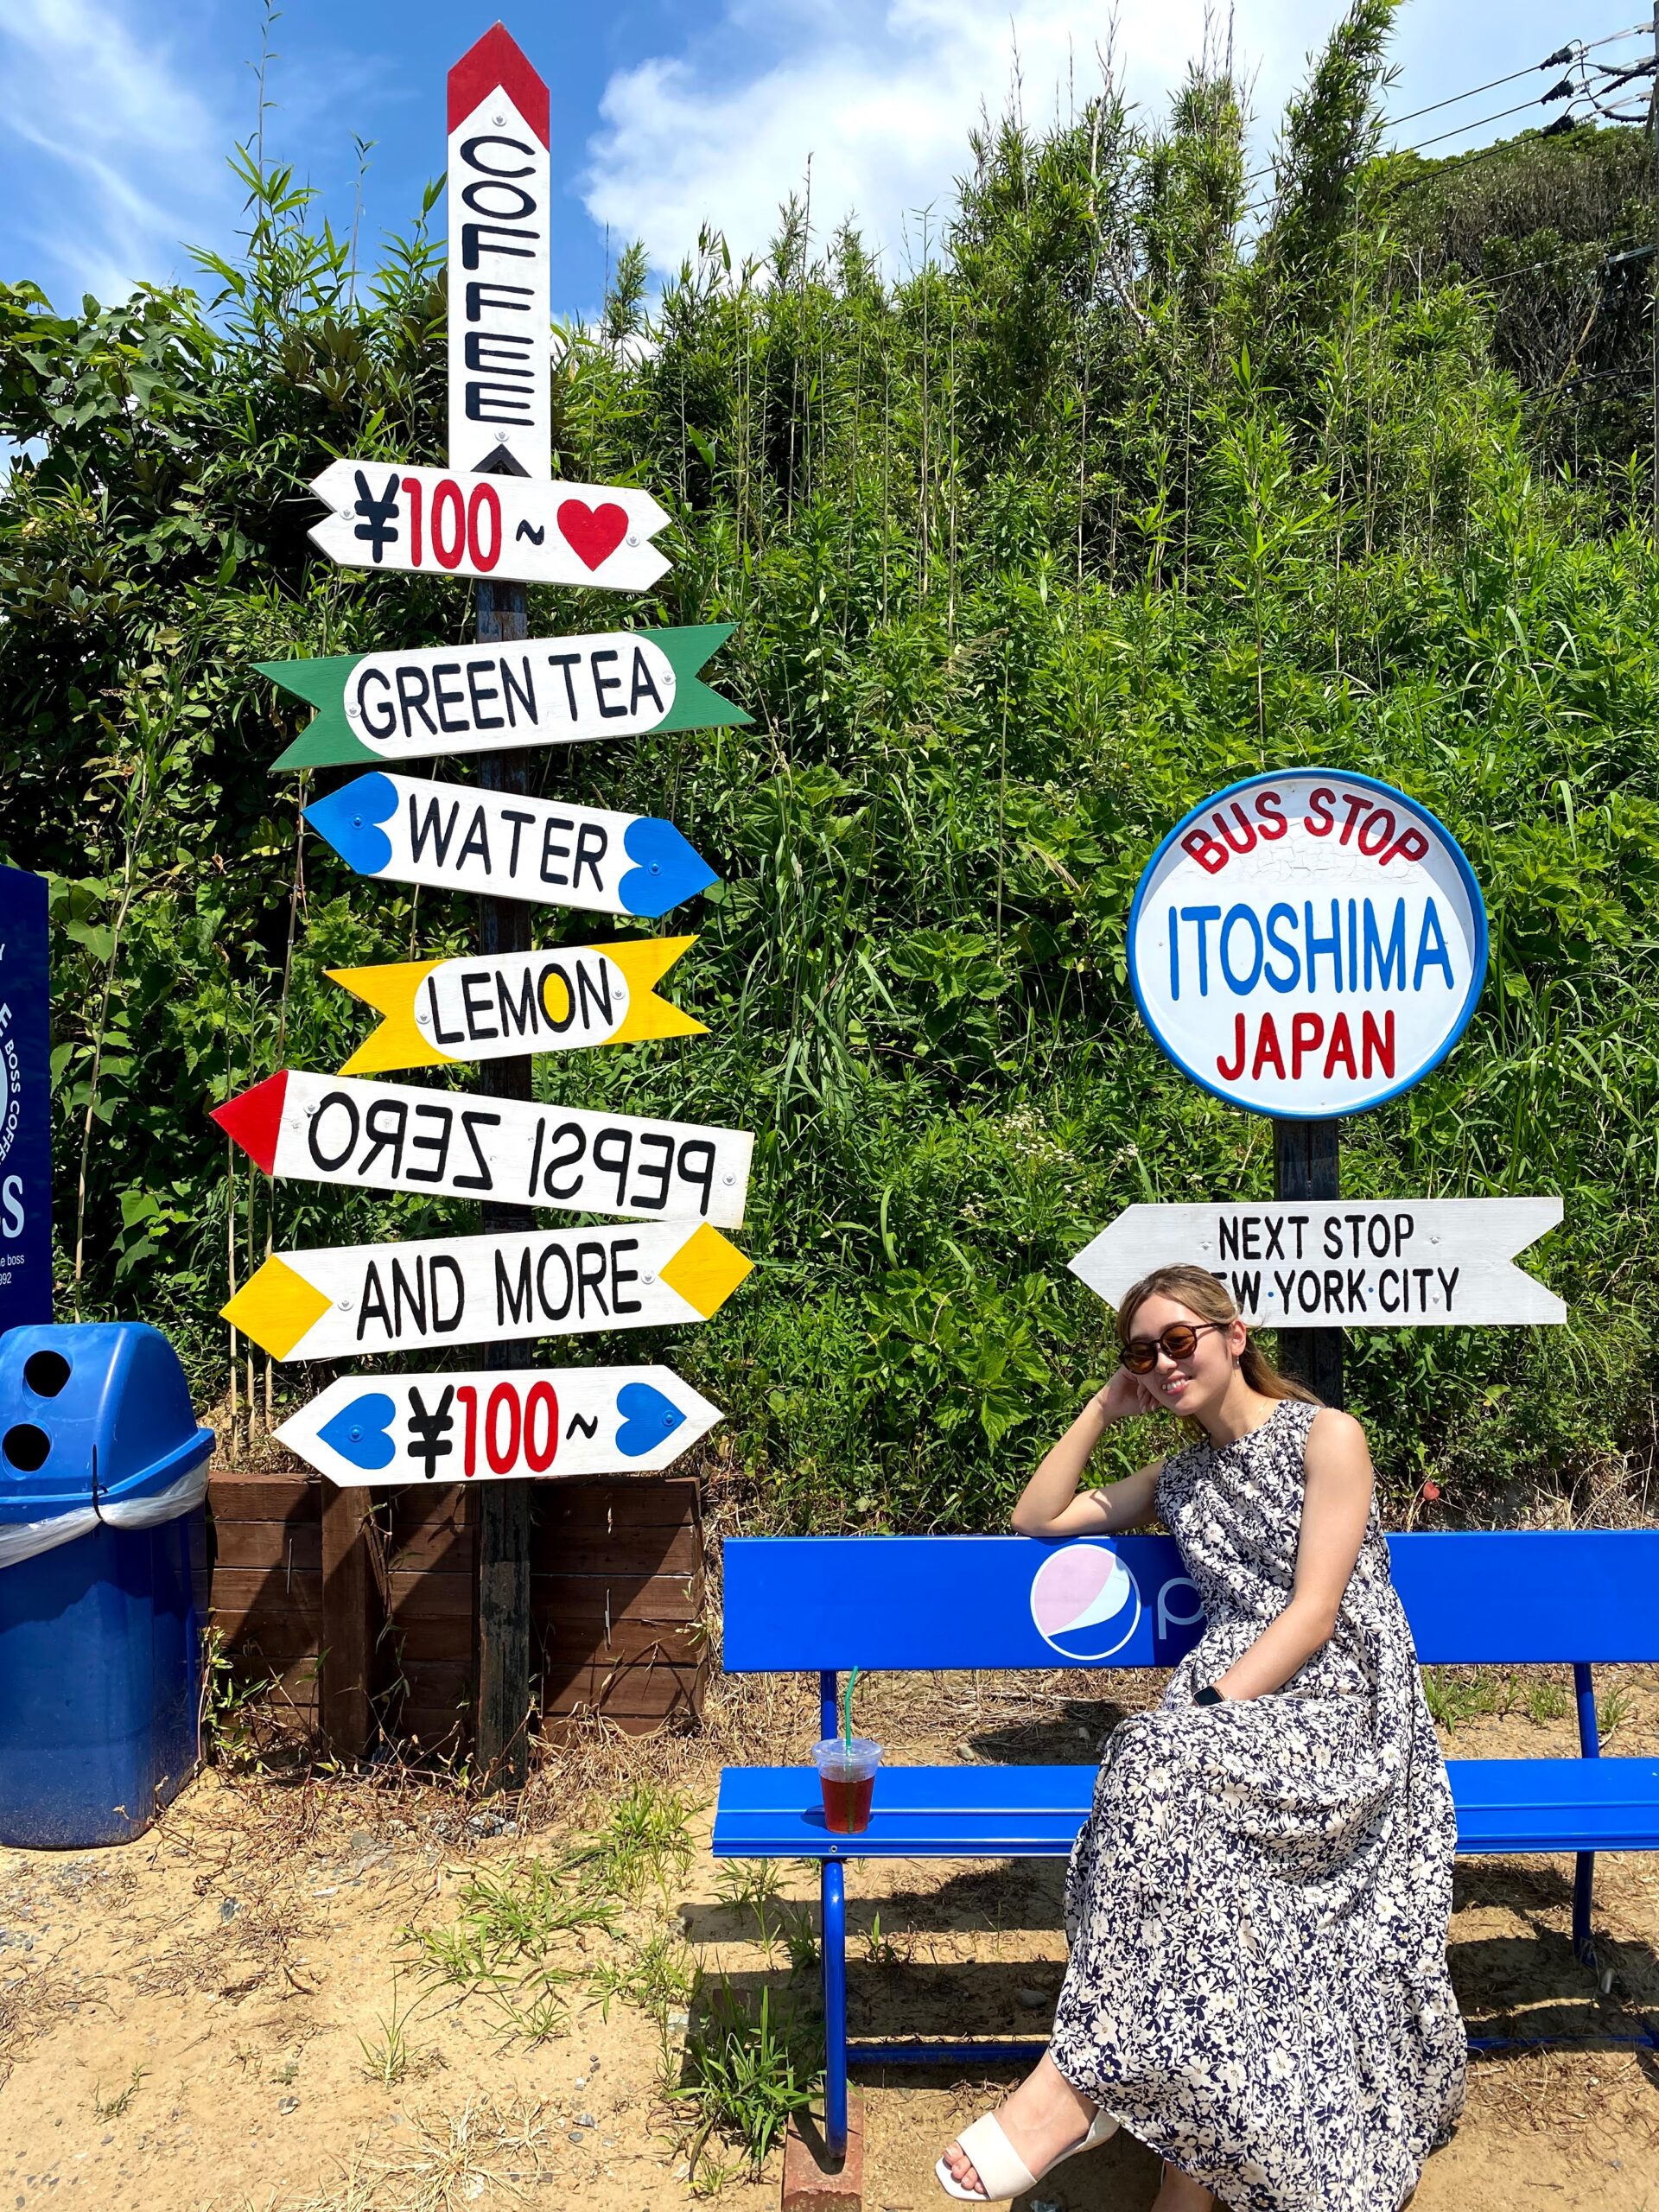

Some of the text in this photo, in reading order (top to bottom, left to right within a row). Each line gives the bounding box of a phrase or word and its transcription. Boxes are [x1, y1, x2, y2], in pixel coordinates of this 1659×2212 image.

[460, 136, 540, 426] COFFEE
[357, 646, 664, 740] GREEN TEA
[409, 793, 609, 893] WATER
[1180, 787, 1429, 874] BUS STOP
[1167, 896, 1455, 1001] ITOSHIMA
[429, 957, 613, 1046] LEMON
[1216, 1009, 1395, 1081] JAPAN
[4, 1039, 21, 1094] BOSS
[0, 1100, 20, 1165] COFFE
[7, 1254, 25, 1266] boss
[1219, 1213, 1414, 1261] NEXT STOP
[357, 1238, 642, 1341] AND MORE
[1274, 1268, 1367, 1315] YORK
[1378, 1267, 1459, 1313] CITY
